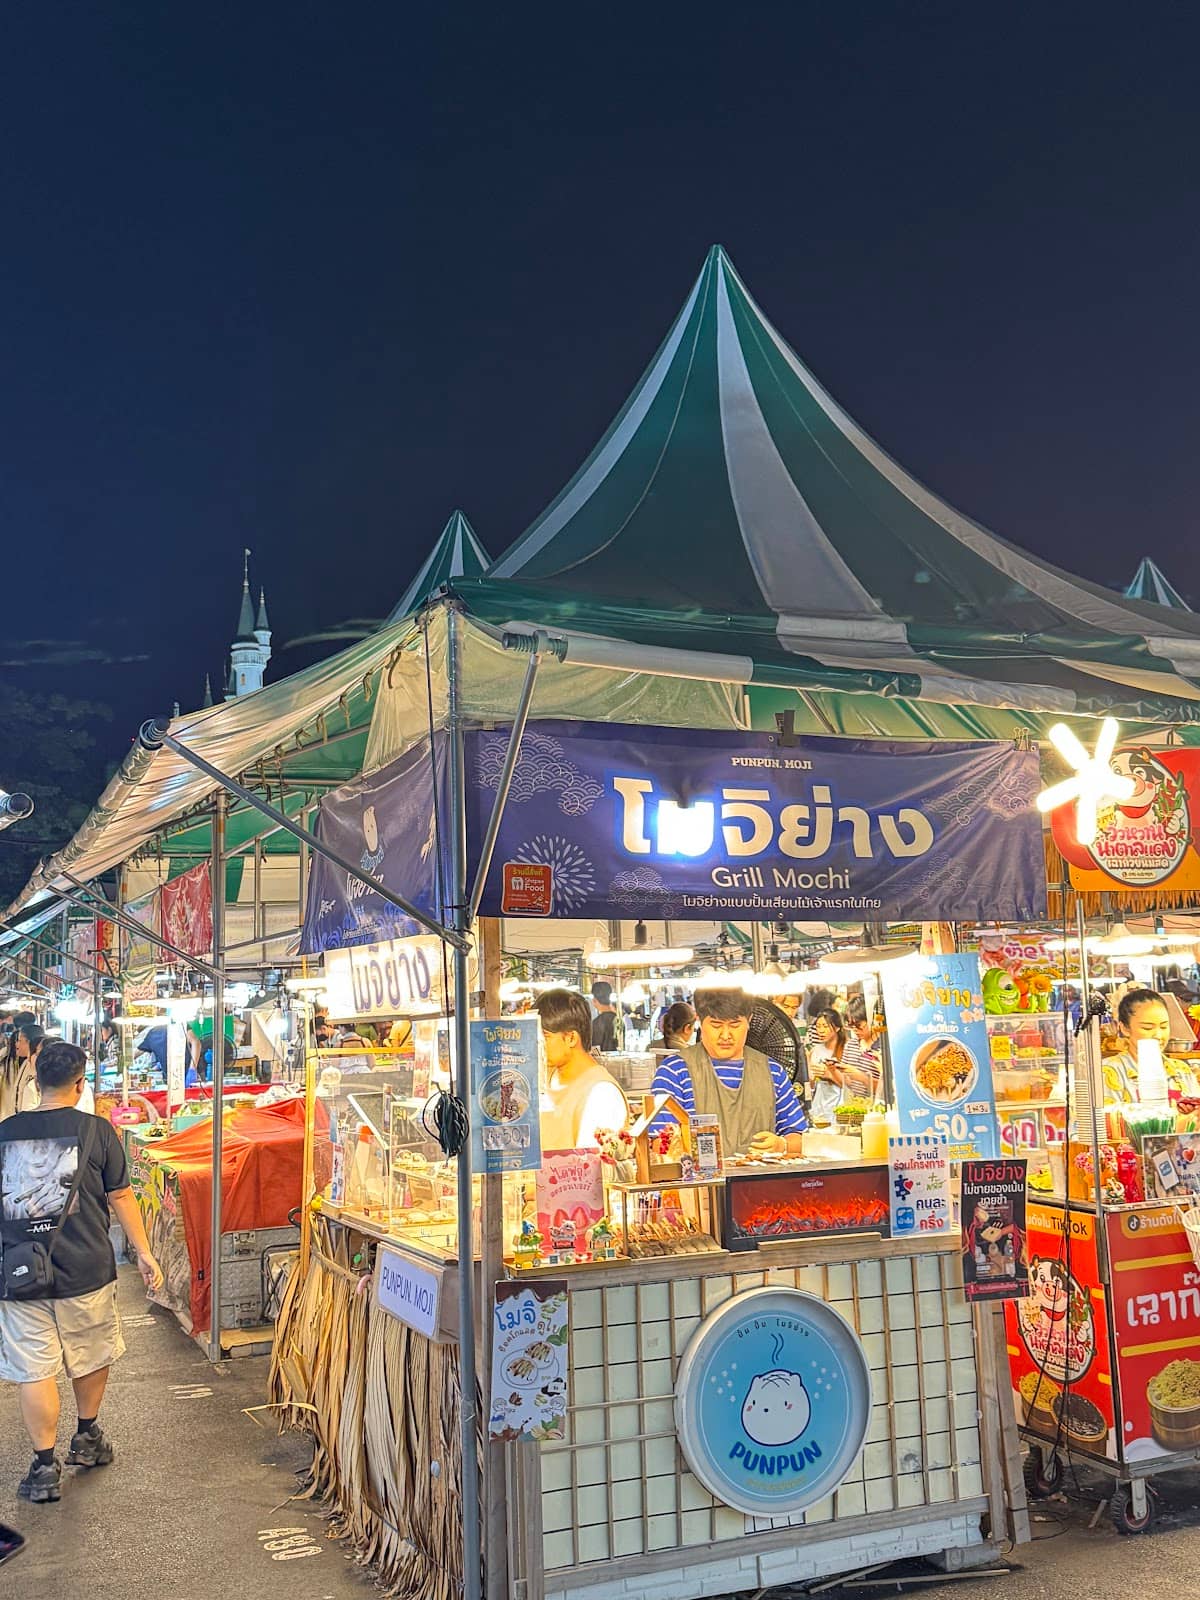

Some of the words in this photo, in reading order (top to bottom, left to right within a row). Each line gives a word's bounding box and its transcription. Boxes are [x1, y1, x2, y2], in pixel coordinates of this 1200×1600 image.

[731, 757, 782, 769] PUNPUN.
[784, 760, 813, 770] MOJI
[613, 776, 934, 859] โมจิย่าง
[711, 867, 764, 888] Grill
[772, 867, 850, 889] Mochi
[917, 1148, 938, 1160] ร้านนี้
[893, 1159, 945, 1171] ร่วมโครงการ
[967, 1161, 1024, 1183] โมจิย่าง
[916, 1199, 946, 1210] คนละ
[920, 1210, 944, 1231] ครึ่ง
[495, 1300, 536, 1331] โมจิ
[729, 1440, 822, 1475] PUNPUN
